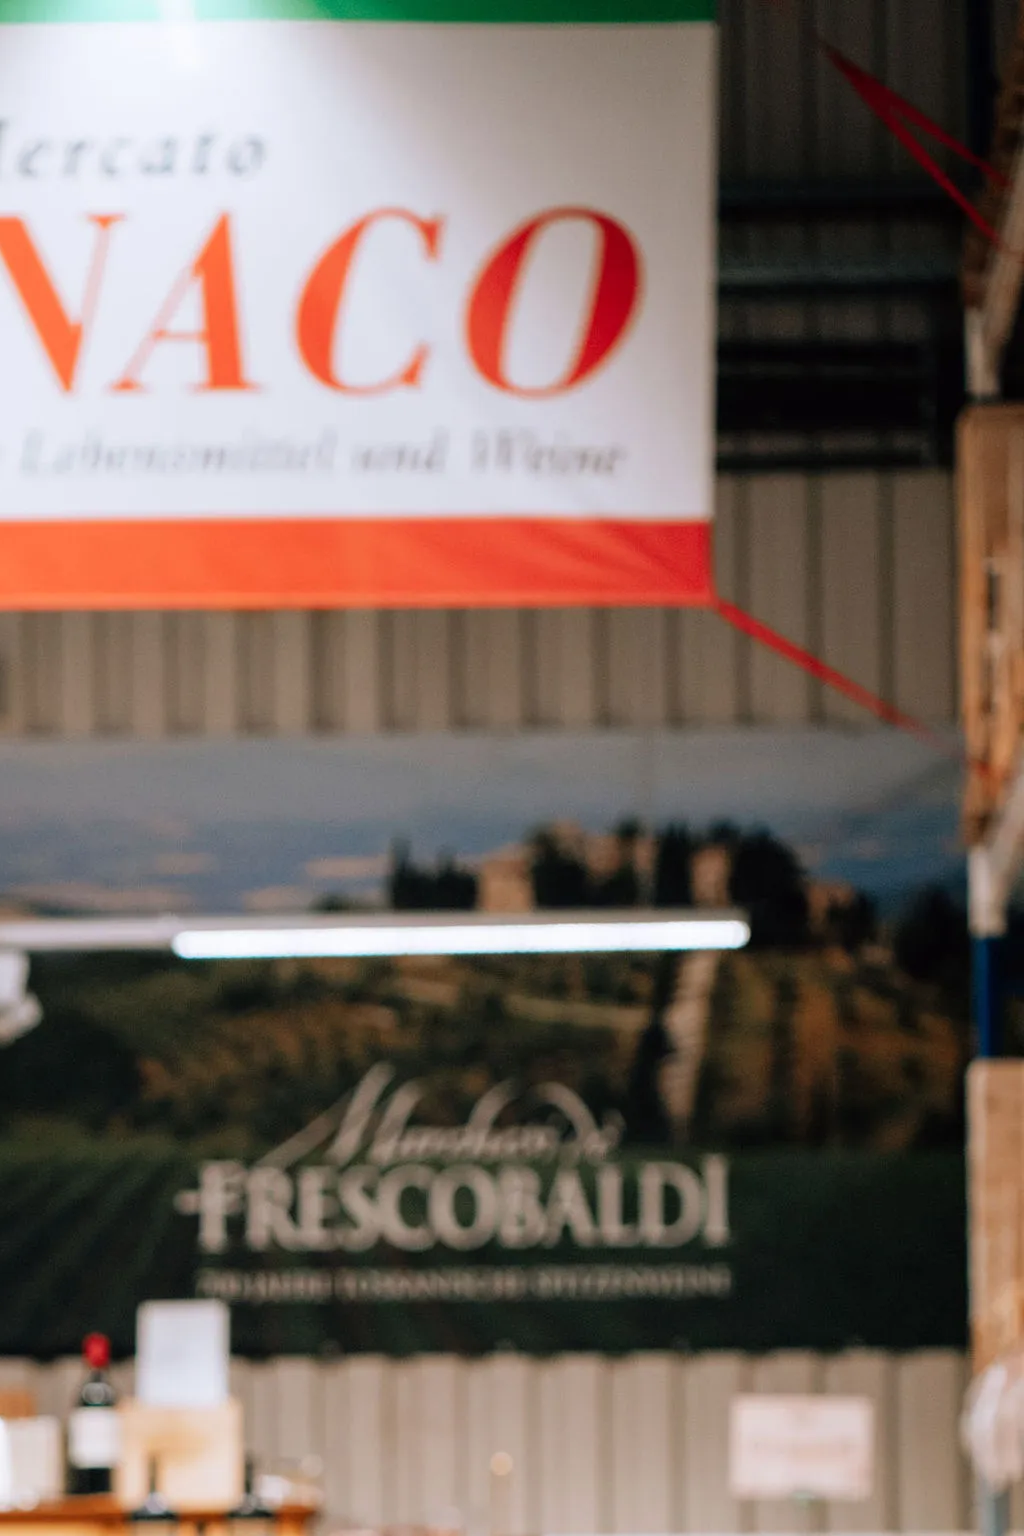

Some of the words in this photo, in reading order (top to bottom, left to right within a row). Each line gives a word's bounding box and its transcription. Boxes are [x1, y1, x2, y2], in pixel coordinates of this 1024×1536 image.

[352, 427, 450, 475] und
[468, 427, 628, 477] Weine
[176, 1153, 731, 1253] FRESCOBALDI
